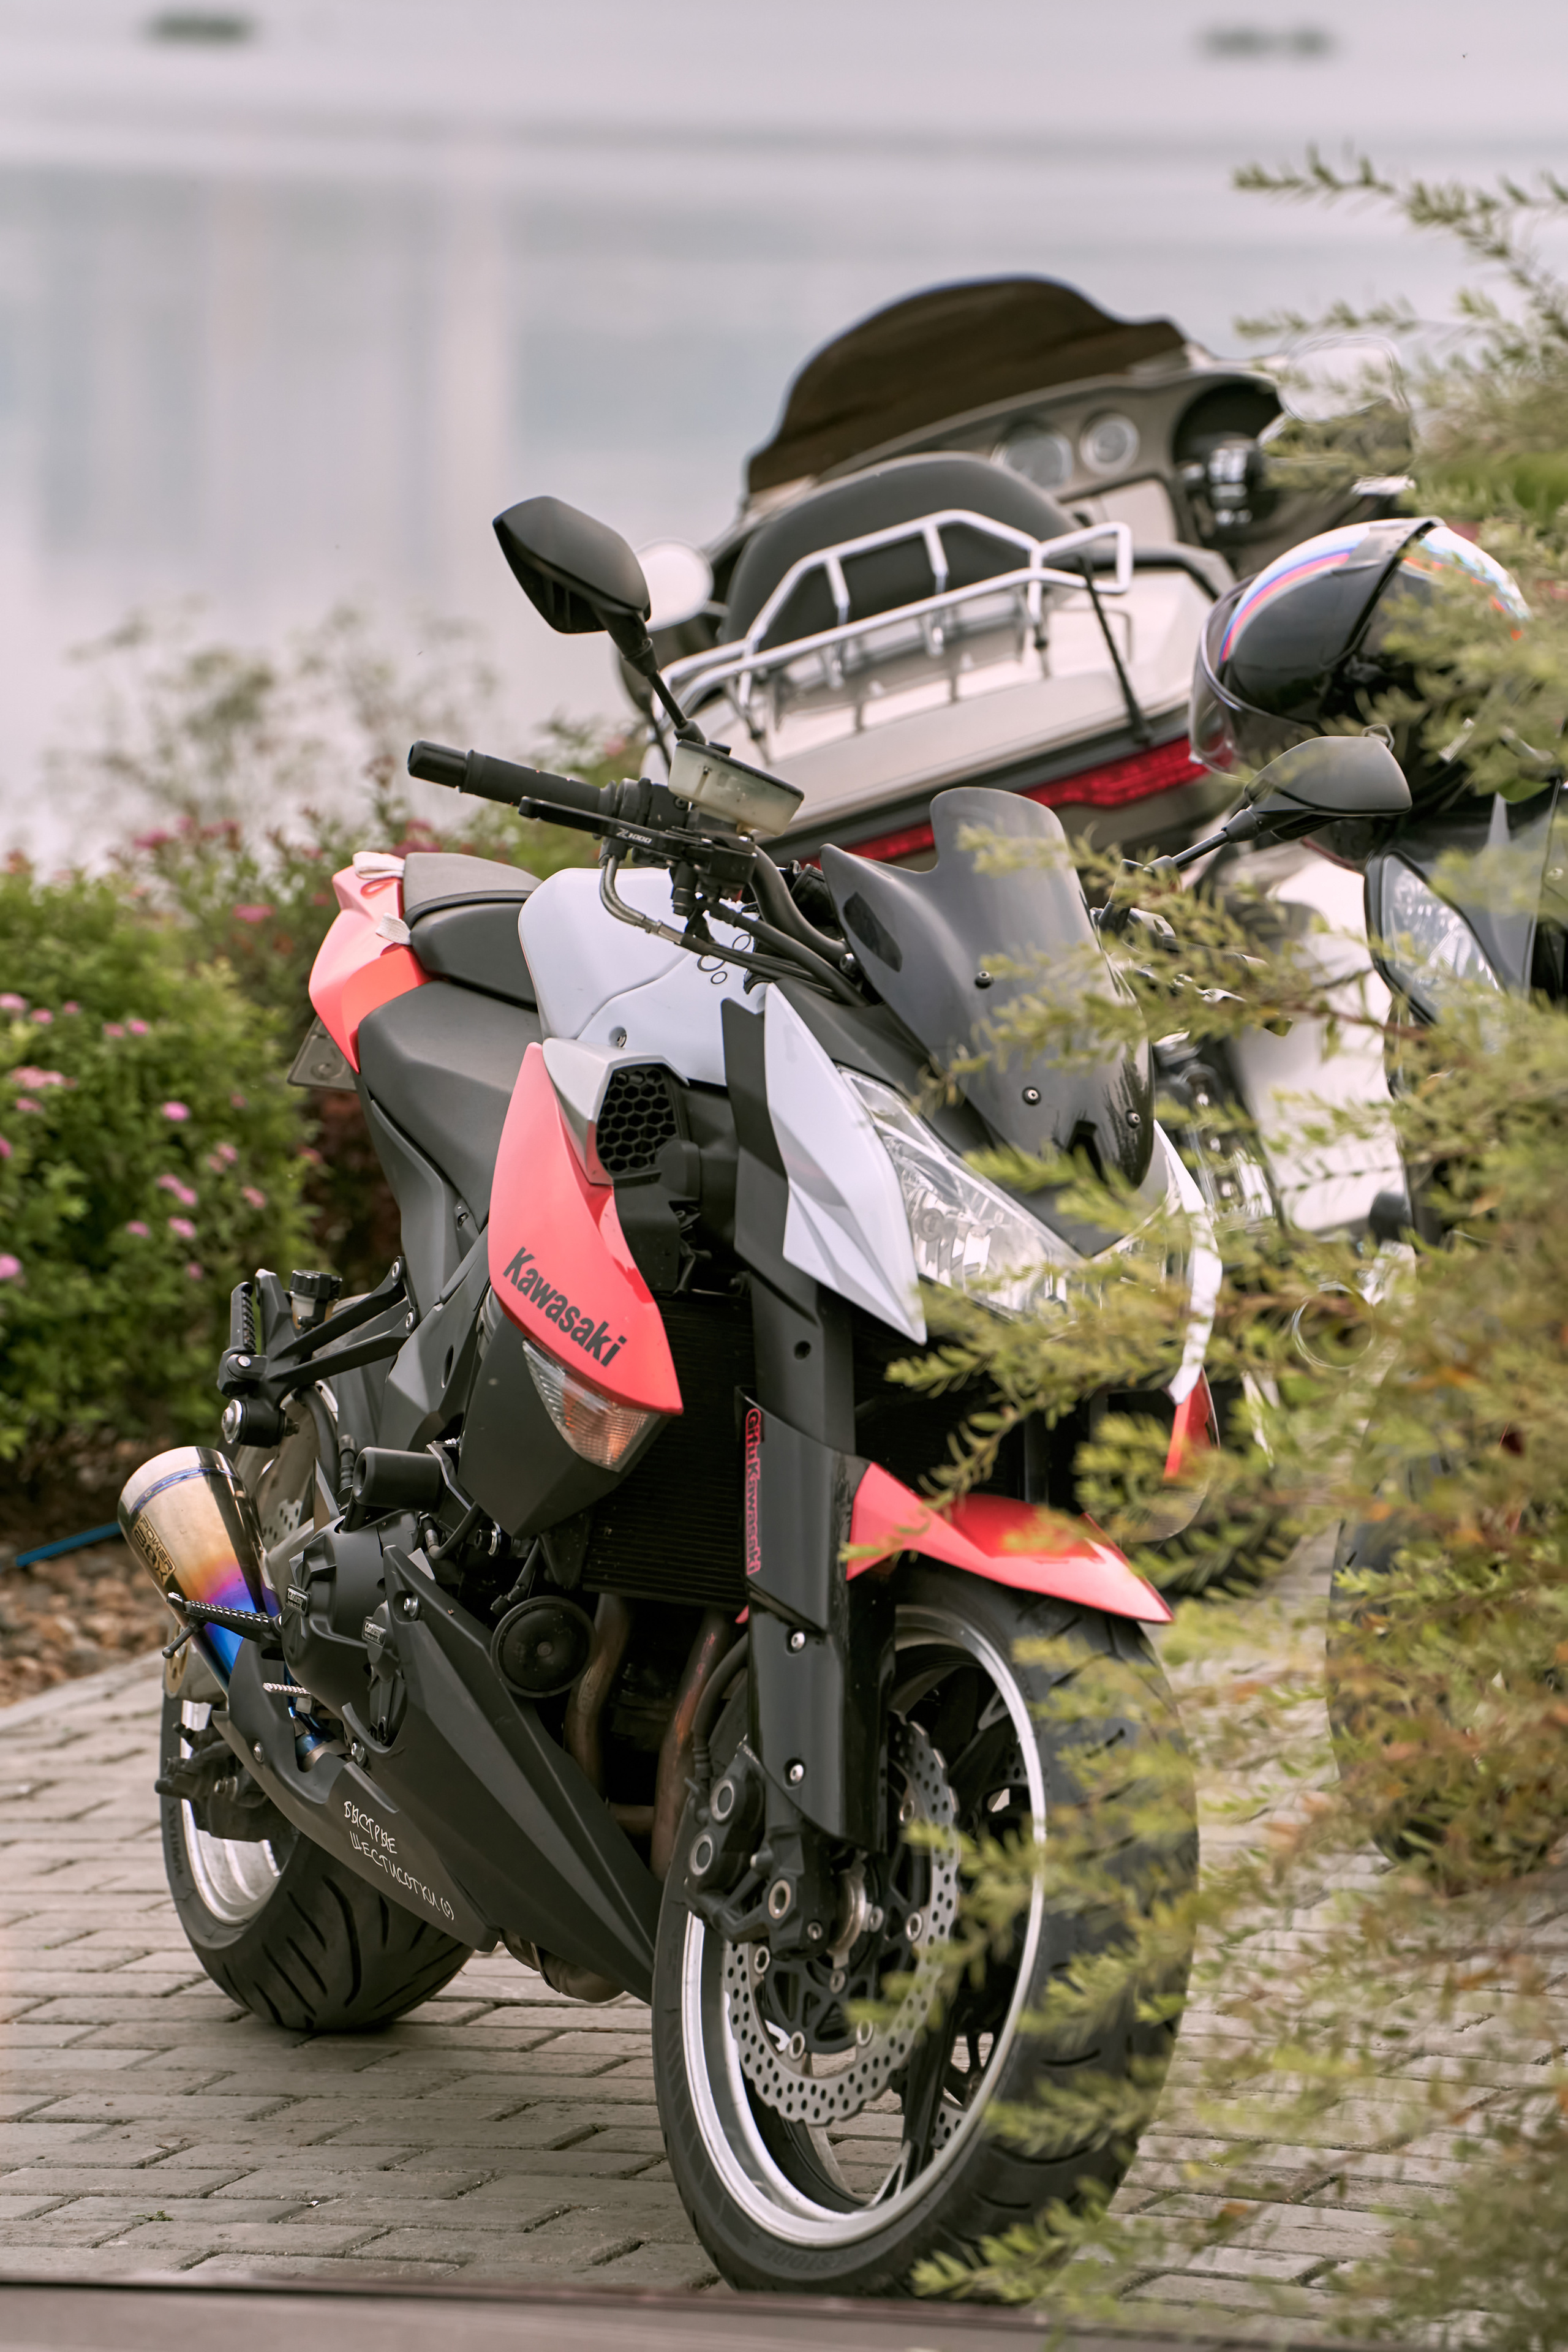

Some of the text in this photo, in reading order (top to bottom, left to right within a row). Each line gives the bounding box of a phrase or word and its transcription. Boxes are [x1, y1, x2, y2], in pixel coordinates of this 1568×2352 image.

[616, 827, 652, 845] Z1000
[503, 1246, 627, 1367] Kawasaki
[140, 1517, 173, 1572] POWER
[344, 1801, 398, 1854] БЫСТРЫЕ
